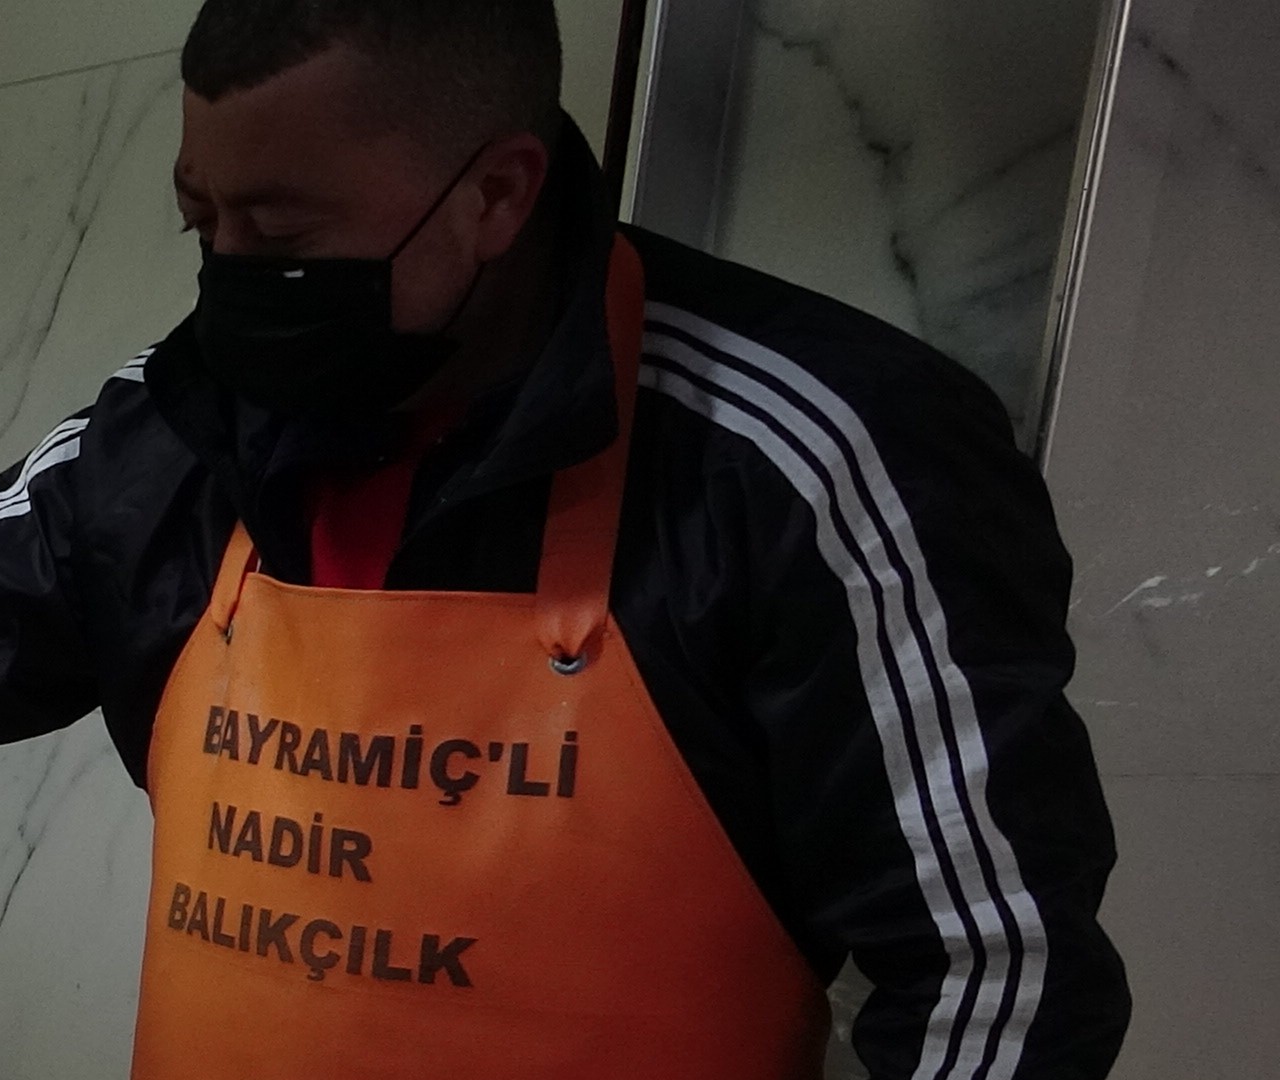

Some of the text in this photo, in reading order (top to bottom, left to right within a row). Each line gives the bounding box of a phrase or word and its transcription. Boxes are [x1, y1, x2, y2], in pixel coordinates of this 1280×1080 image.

[203, 705, 579, 806] BAYRAMİÇ'Lİ
[207, 801, 373, 883] NADİR
[168, 882, 480, 988] BALIKÇILK
